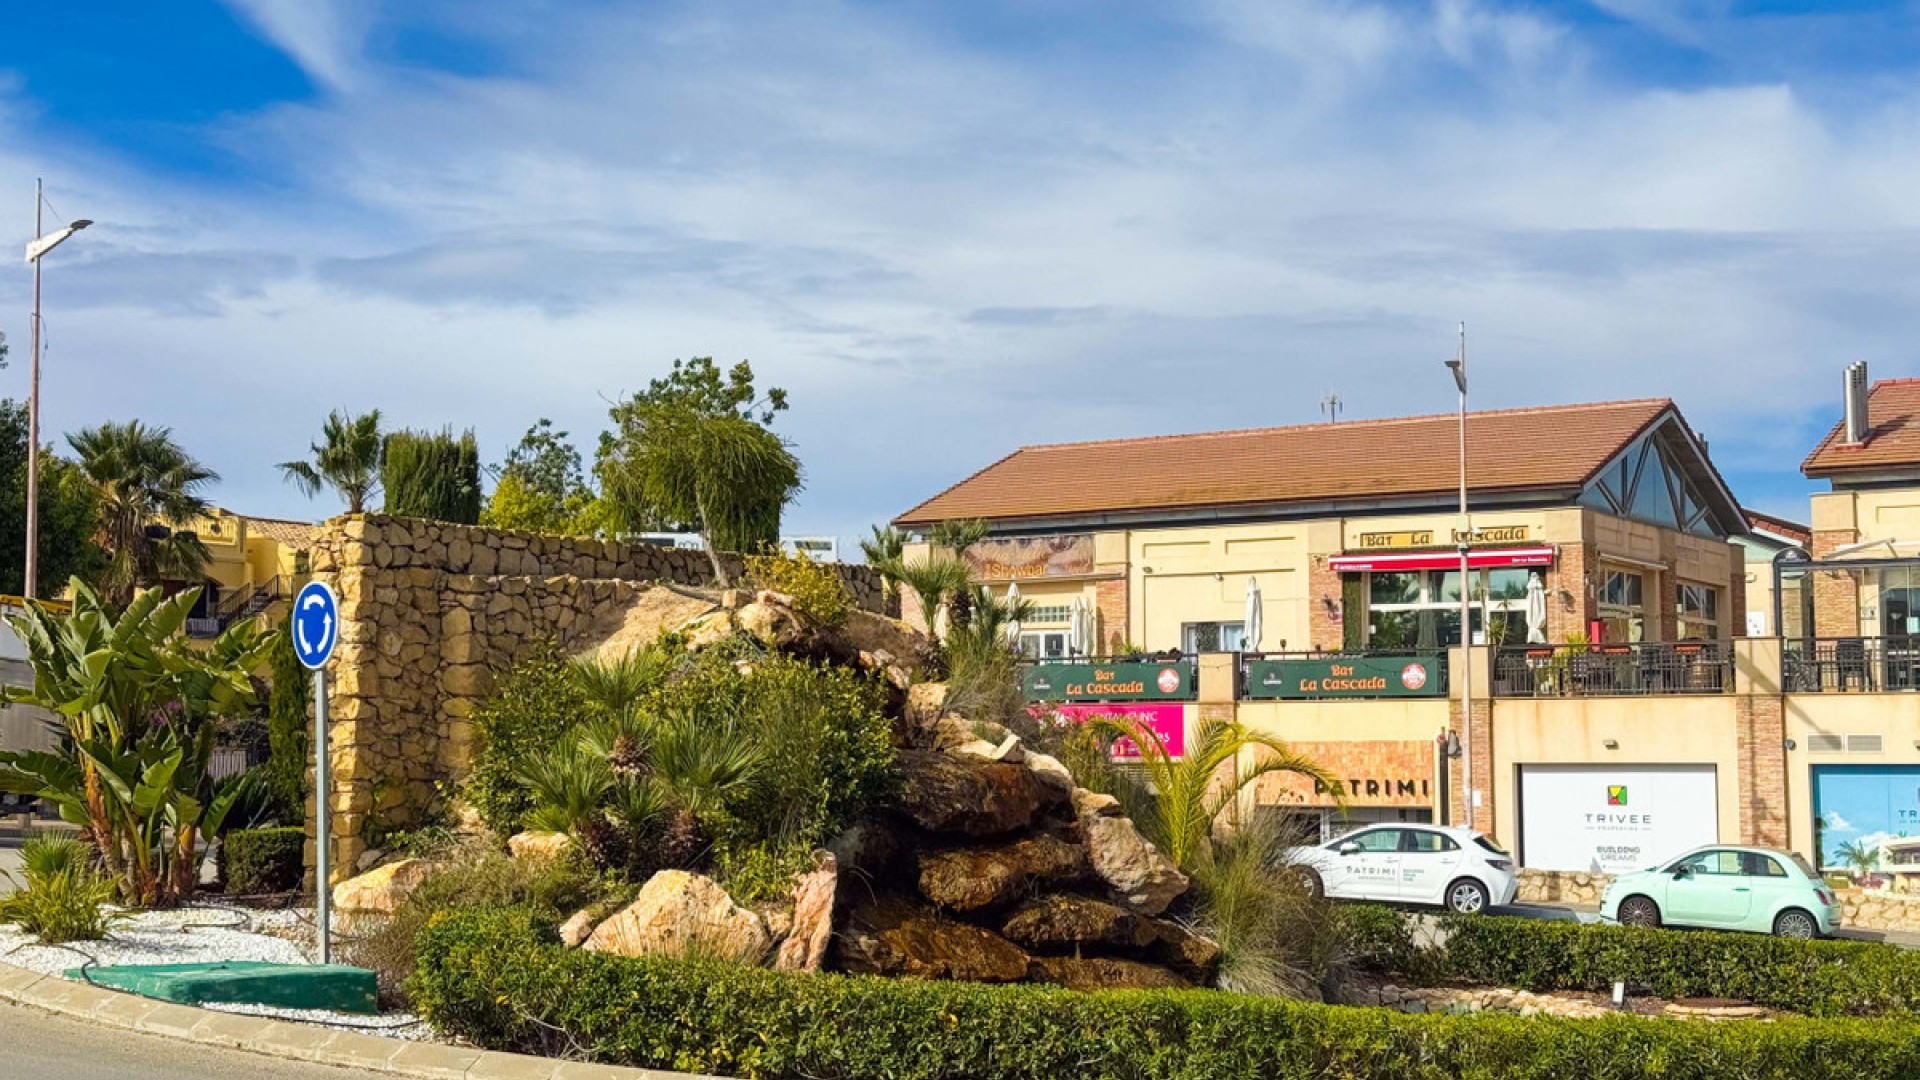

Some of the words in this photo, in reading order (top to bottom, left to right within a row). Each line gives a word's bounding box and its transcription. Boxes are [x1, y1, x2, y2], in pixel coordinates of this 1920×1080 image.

[1367, 533, 1392, 546] Bar
[1411, 531, 1430, 544] La
[1094, 669, 1115, 681] Bar
[1331, 664, 1354, 677] Bar
[1066, 683, 1082, 695] La
[1086, 681, 1144, 695] Cascada
[1299, 679, 1318, 692] La
[1322, 676, 1387, 691] Cascada
[1584, 813, 1652, 824] TRIVEE
[1346, 865, 1396, 876] PATRIMI
